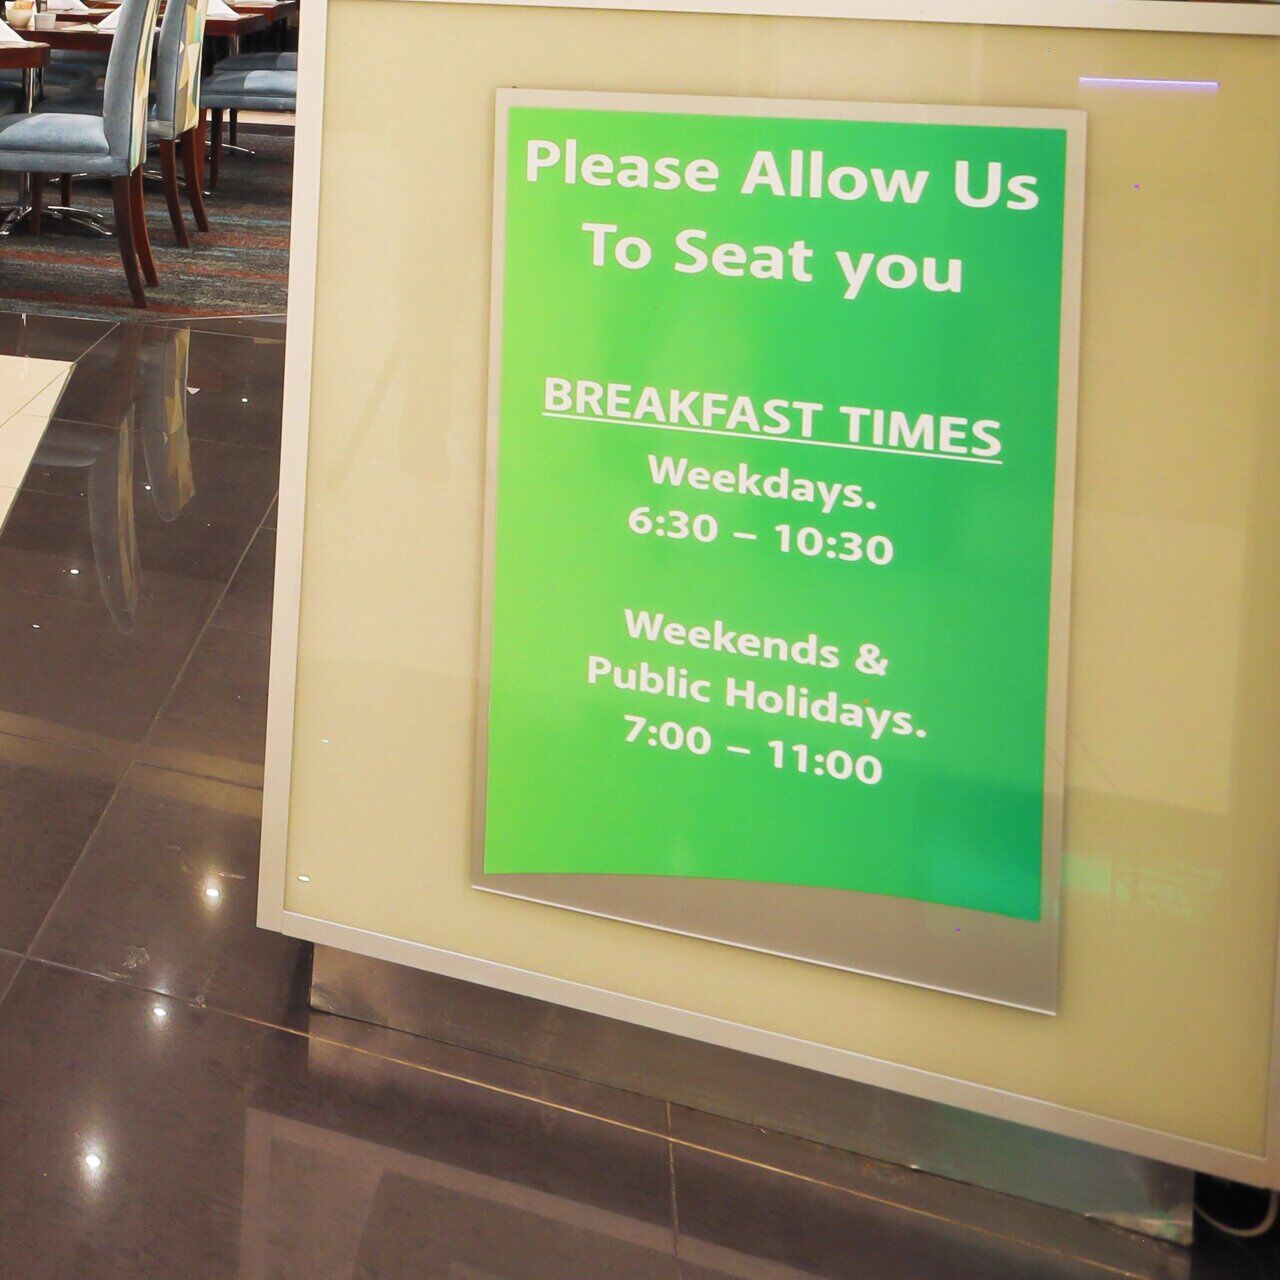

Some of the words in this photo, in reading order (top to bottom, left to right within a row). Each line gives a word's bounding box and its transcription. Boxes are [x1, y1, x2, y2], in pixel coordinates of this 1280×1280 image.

[526, 139, 719, 193] Please
[740, 149, 930, 204] Allow
[955, 160, 1039, 210] Us
[581, 222, 652, 270] To
[674, 228, 814, 282] Seat
[836, 251, 962, 300] you
[544, 376, 824, 438] BREAKFAST
[839, 406, 1001, 457] TIMES
[648, 454, 877, 514] Weekdays.
[628, 506, 718, 543] 6:30
[775, 524, 894, 565] 10:30
[624, 608, 840, 668] Weekends
[854, 643, 889, 676] &
[587, 655, 711, 703] Public
[725, 677, 927, 740] Holidays.
[624, 714, 712, 755] 7:00
[768, 740, 882, 785] 11:00
